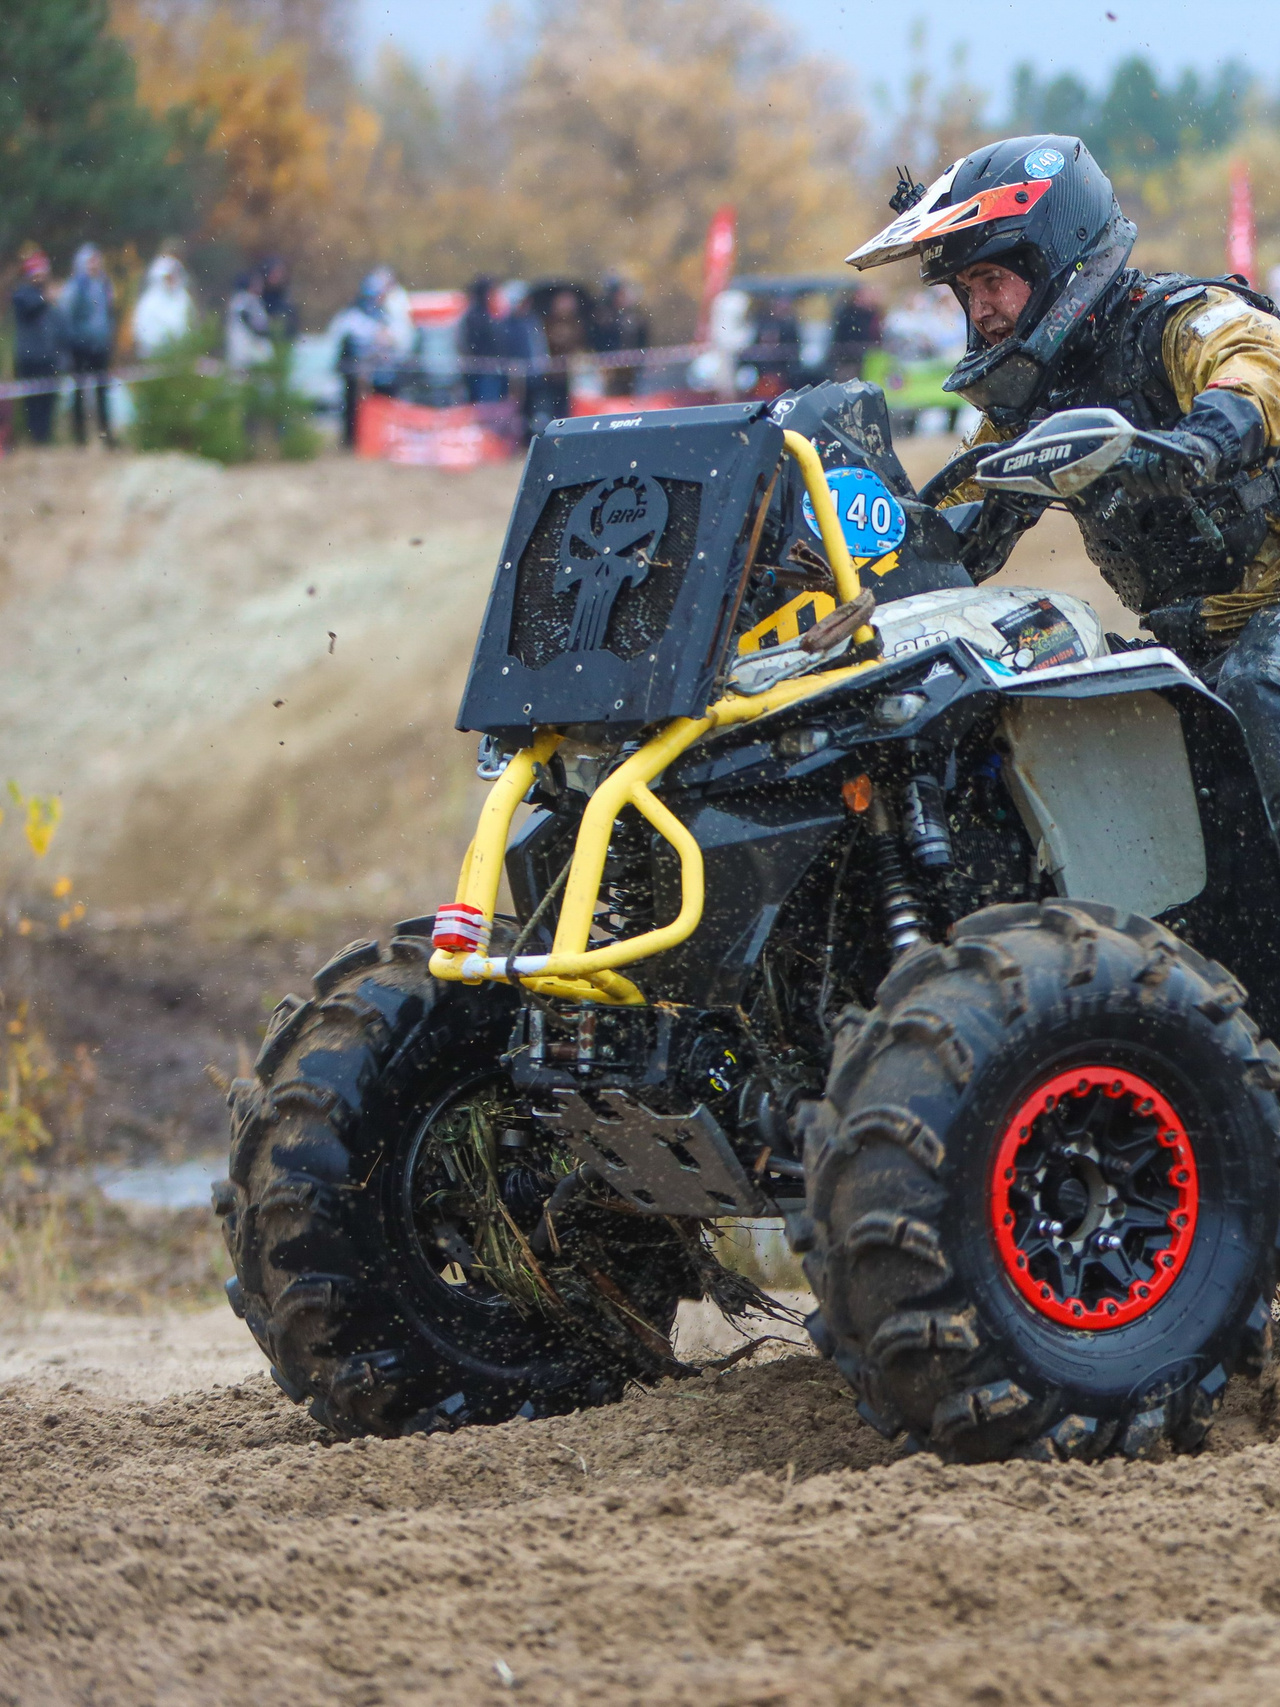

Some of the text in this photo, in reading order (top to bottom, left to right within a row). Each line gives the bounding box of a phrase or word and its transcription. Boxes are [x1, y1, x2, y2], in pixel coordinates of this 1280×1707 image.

[1032, 152, 1058, 172] 140
[609, 417, 643, 430] sport
[1002, 443, 1072, 473] can-am
[606, 508, 646, 525] BRP
